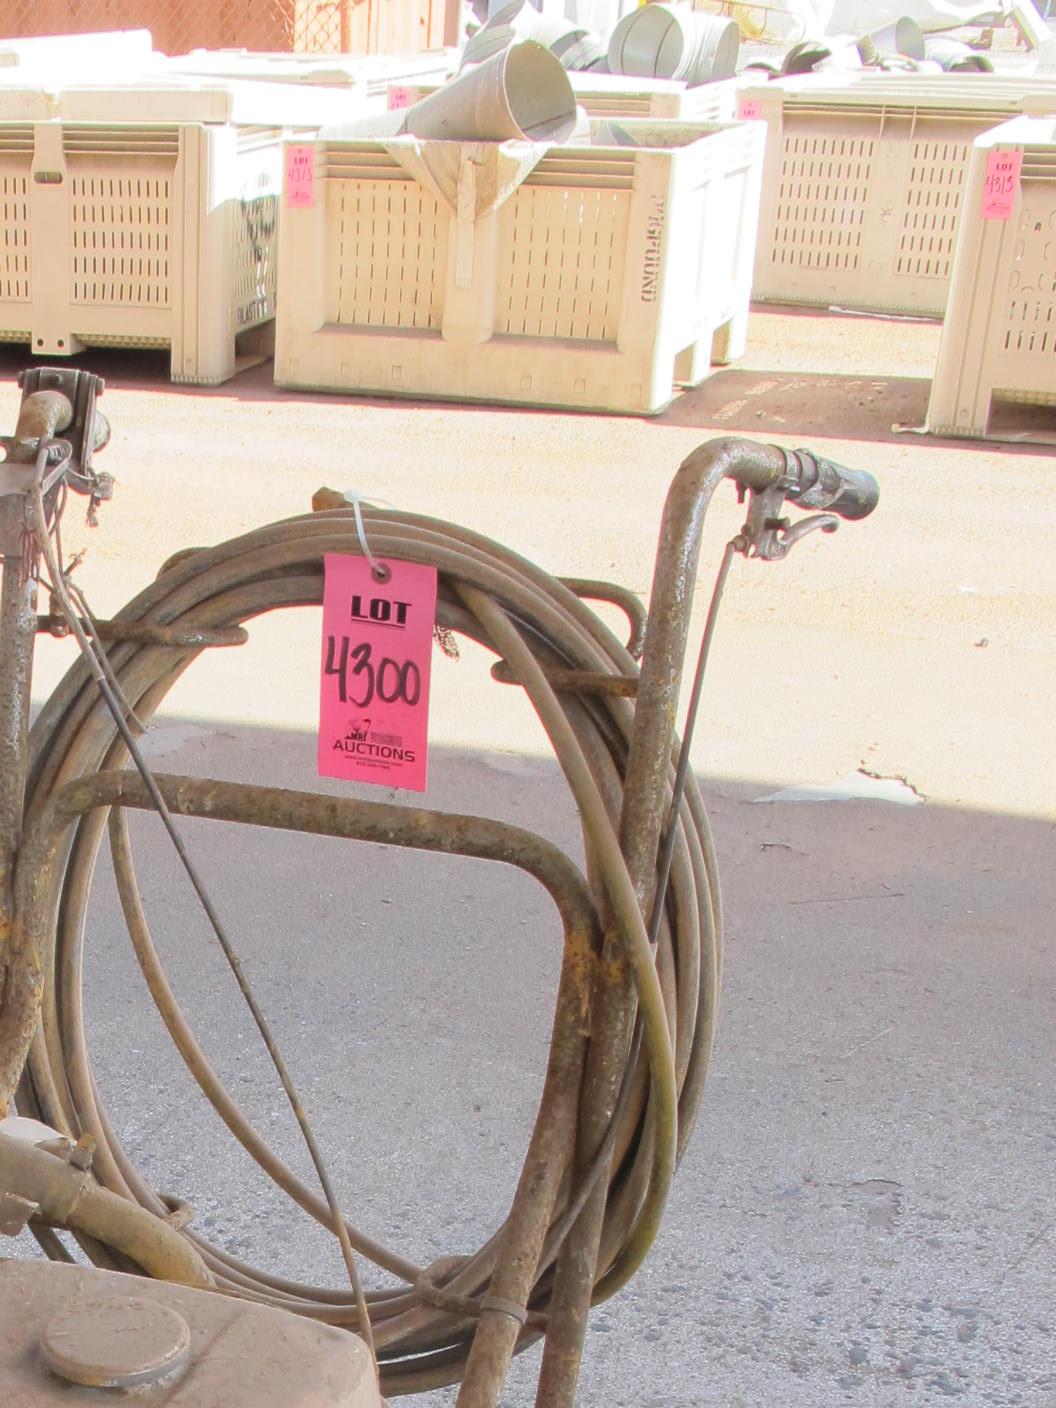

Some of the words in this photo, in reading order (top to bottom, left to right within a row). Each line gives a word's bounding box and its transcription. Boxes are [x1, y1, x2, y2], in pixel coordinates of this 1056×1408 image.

[351, 595, 412, 625] LOT
[324, 635, 421, 708] 4300
[333, 740, 416, 762] AUCTIONS
